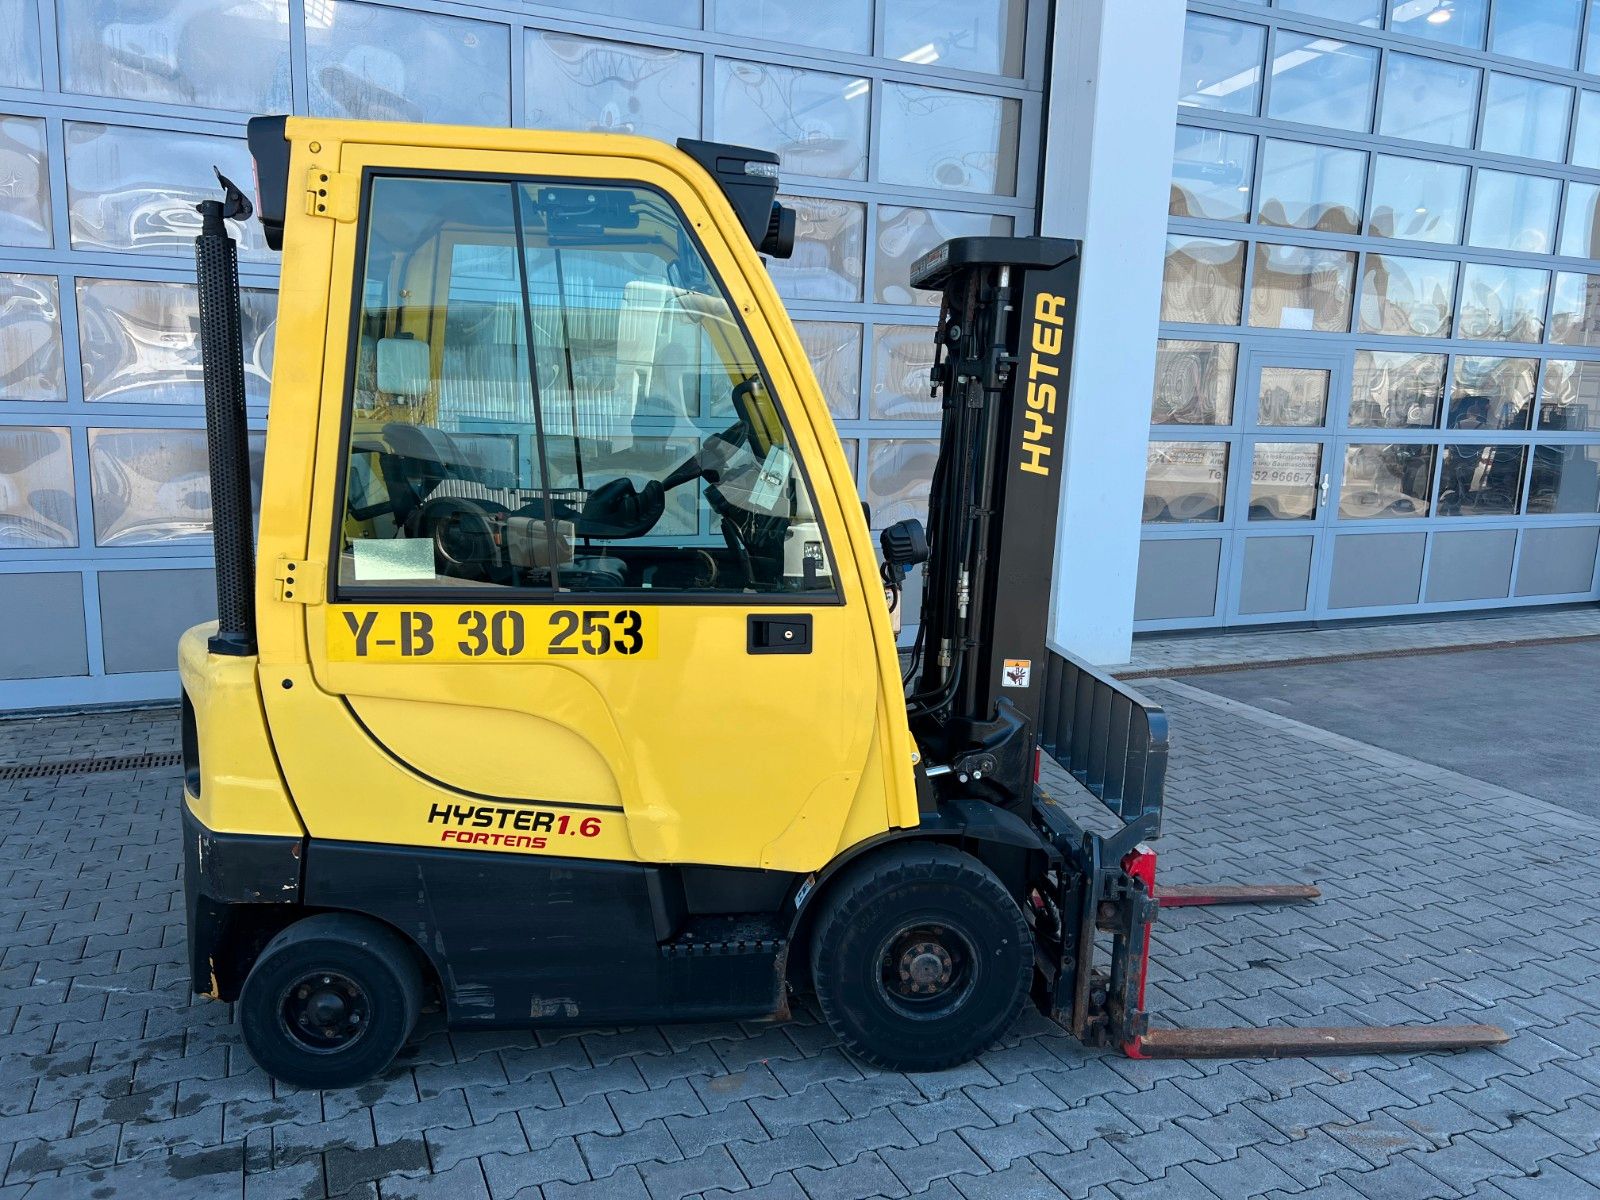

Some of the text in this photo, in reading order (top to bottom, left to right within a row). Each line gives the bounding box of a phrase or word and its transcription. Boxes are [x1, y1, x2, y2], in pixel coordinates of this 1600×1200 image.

[1020, 292, 1066, 476] HYSTER
[1208, 469, 1222, 480] Te
[1253, 471, 1268, 481] 52
[342, 610, 644, 657] Y-B 30 253
[428, 803, 602, 838] HYSTER 1.6
